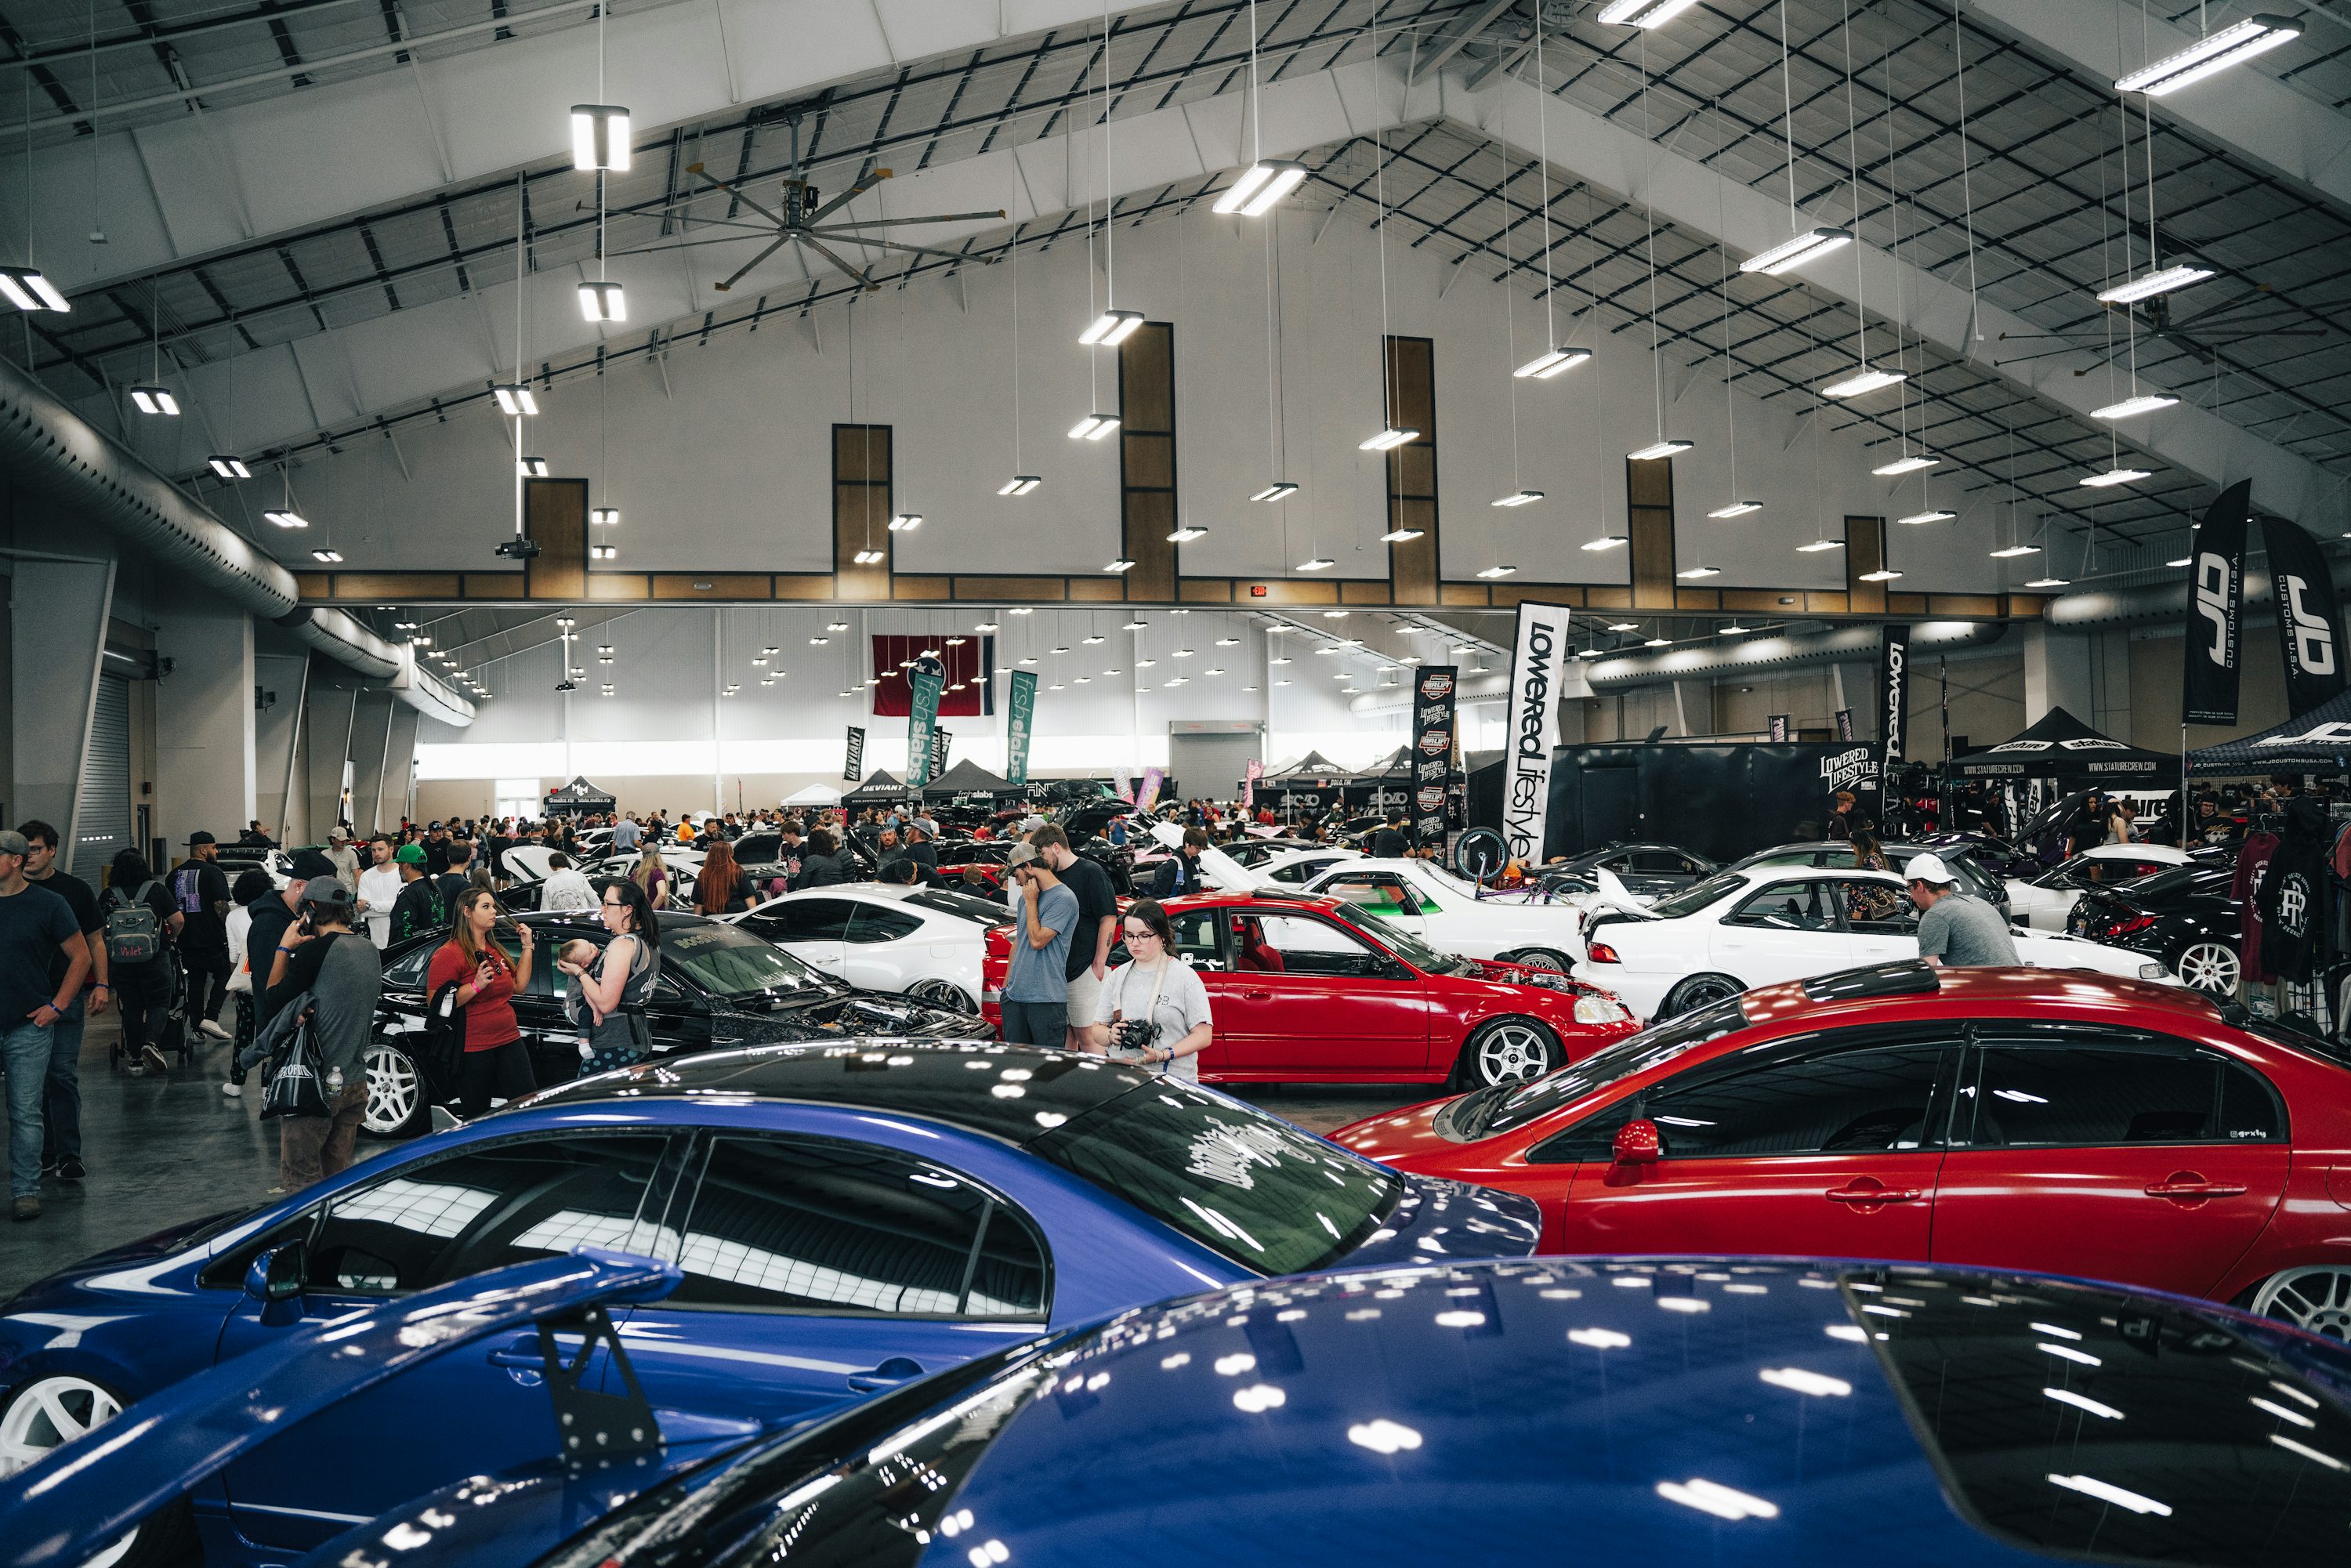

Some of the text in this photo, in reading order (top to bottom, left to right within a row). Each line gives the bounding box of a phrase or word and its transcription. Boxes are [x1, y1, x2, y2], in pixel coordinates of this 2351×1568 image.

[2226, 552, 2239, 668] CUSTOMS U.S.A.
[2278, 575, 2299, 679] CUSTOMS U.S.A.
[1420, 704, 1446, 719] LOWERED
[1424, 711, 1450, 726] LIFESTYLE
[1418, 760, 1444, 773] LOWERED
[1820, 748, 1868, 778] LOWERED
[2088, 762, 2156, 772] WWW.STATURECREW.COM
[1828, 761, 1879, 795] LIFESTYLE
[958, 790, 994, 799] frshslabs
[1418, 817, 1440, 830] LOWERED
[120, 946, 142, 957] Violet
